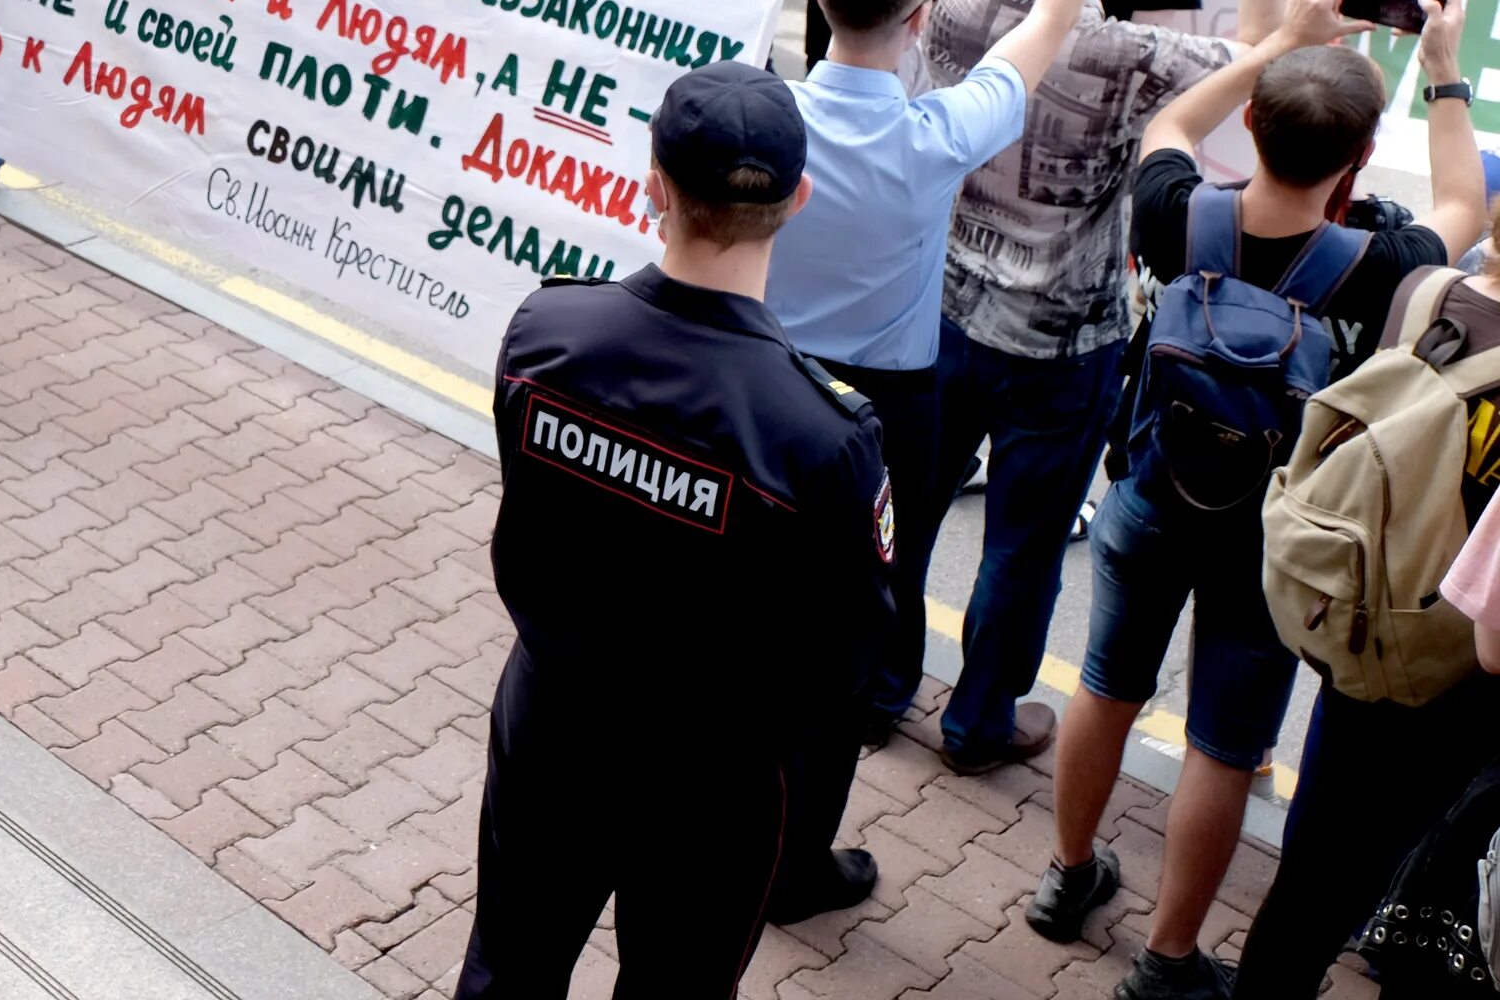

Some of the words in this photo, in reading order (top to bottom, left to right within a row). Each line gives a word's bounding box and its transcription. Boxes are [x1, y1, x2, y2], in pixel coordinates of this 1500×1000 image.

[137, 7, 238, 73] своей
[22, 36, 45, 74] к
[63, 41, 205, 136] Людям
[246, 119, 406, 214] своими
[541, 59, 617, 127] НЕ
[324, 216, 472, 320] Креститель
[533, 410, 719, 517] ПОЛИЦИЯ
